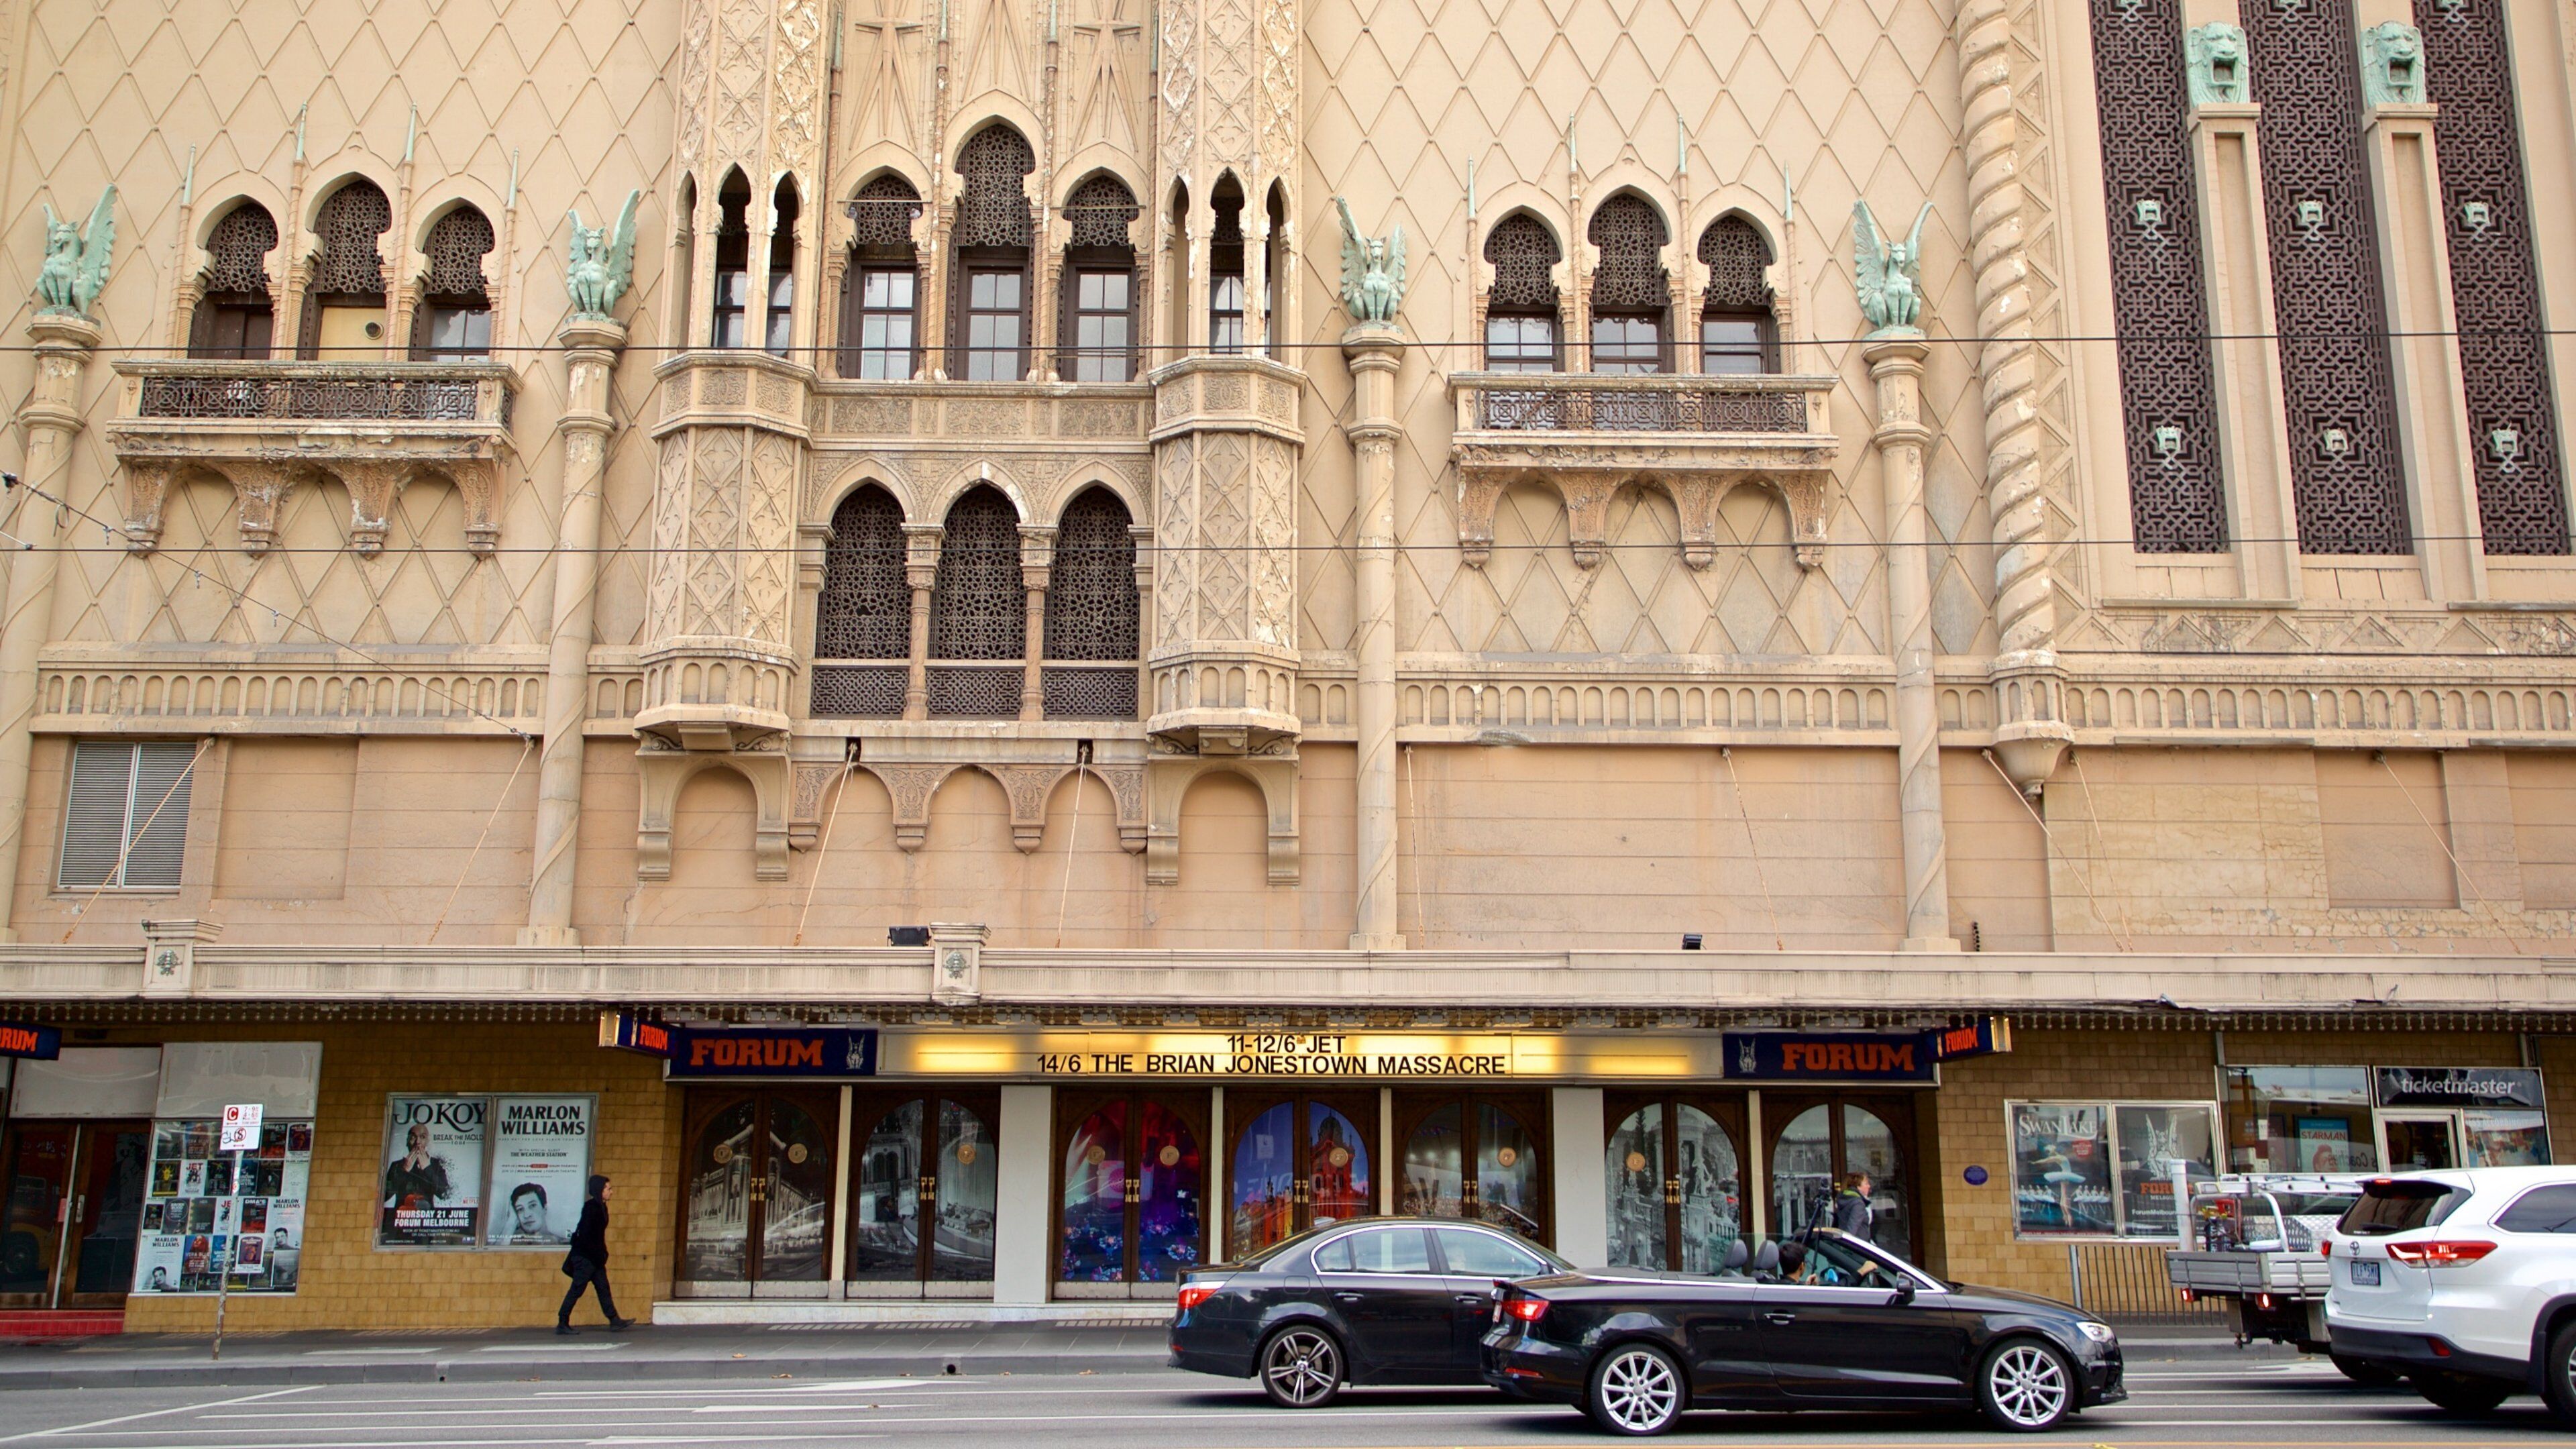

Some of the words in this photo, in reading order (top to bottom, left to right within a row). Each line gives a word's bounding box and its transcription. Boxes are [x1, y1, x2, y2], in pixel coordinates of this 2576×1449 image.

[639, 1024, 668, 1051] FORUM
[1227, 1035, 1296, 1053] 11-12/6
[1306, 1035, 1346, 1053] JET
[1945, 1026, 1979, 1053] FORUM
[690, 1038, 824, 1066] FORUM
[1781, 1043, 1916, 1071] FORUM
[1037, 1055, 1081, 1073] 14/6
[1091, 1055, 1133, 1073] THE
[1146, 1055, 1215, 1073] BRIAN
[1224, 1055, 1367, 1074] JONESTOWN
[1377, 1055, 1505, 1074] MASSACRE
[2401, 1076, 2515, 1094] ticketmaster
[228, 1108, 237, 1120] C
[508, 1106, 581, 1120] MARLON
[501, 1121, 586, 1135] WILLIAMS
[2301, 1130, 2346, 1140] STARMAN
[394, 1219, 421, 1227] FORUM
[423, 1219, 470, 1227] MELBOURNE
[396, 1210, 435, 1218] THURSDAY
[437, 1210, 445, 1218] 21
[449, 1210, 470, 1218] JUNE
